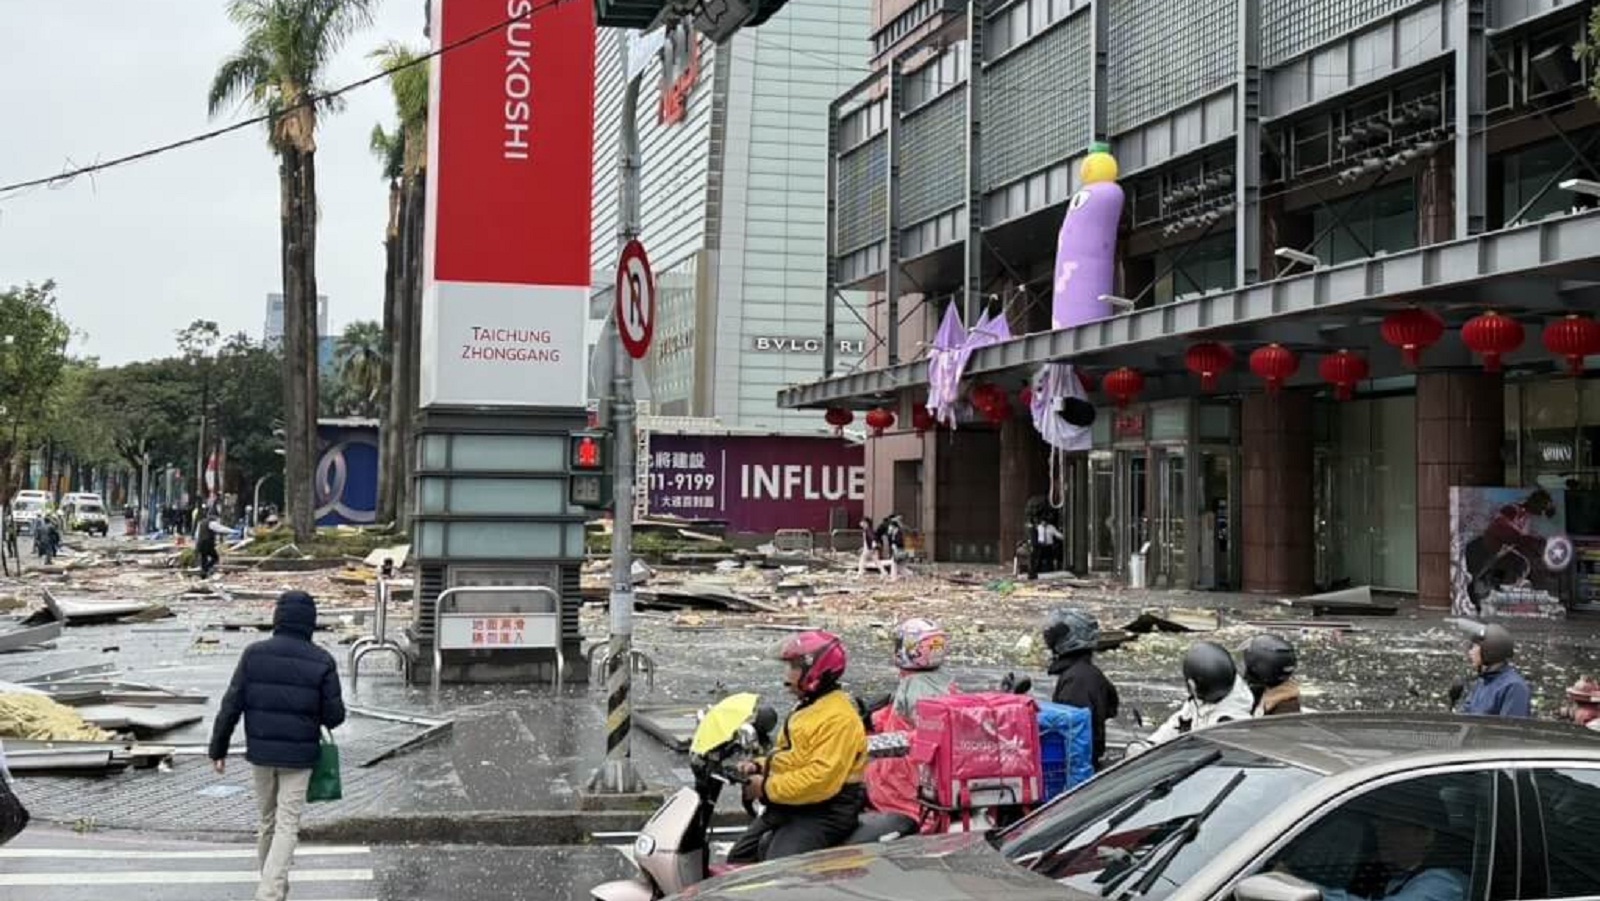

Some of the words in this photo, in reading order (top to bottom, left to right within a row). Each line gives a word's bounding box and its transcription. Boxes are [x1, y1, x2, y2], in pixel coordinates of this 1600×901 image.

[503, 0, 532, 159] SUKOSHI
[472, 326, 551, 344] TAICHUNG
[462, 345, 560, 363] ZHONGGANG
[757, 337, 864, 353] BVLGRI
[741, 464, 864, 500] INFLUE
